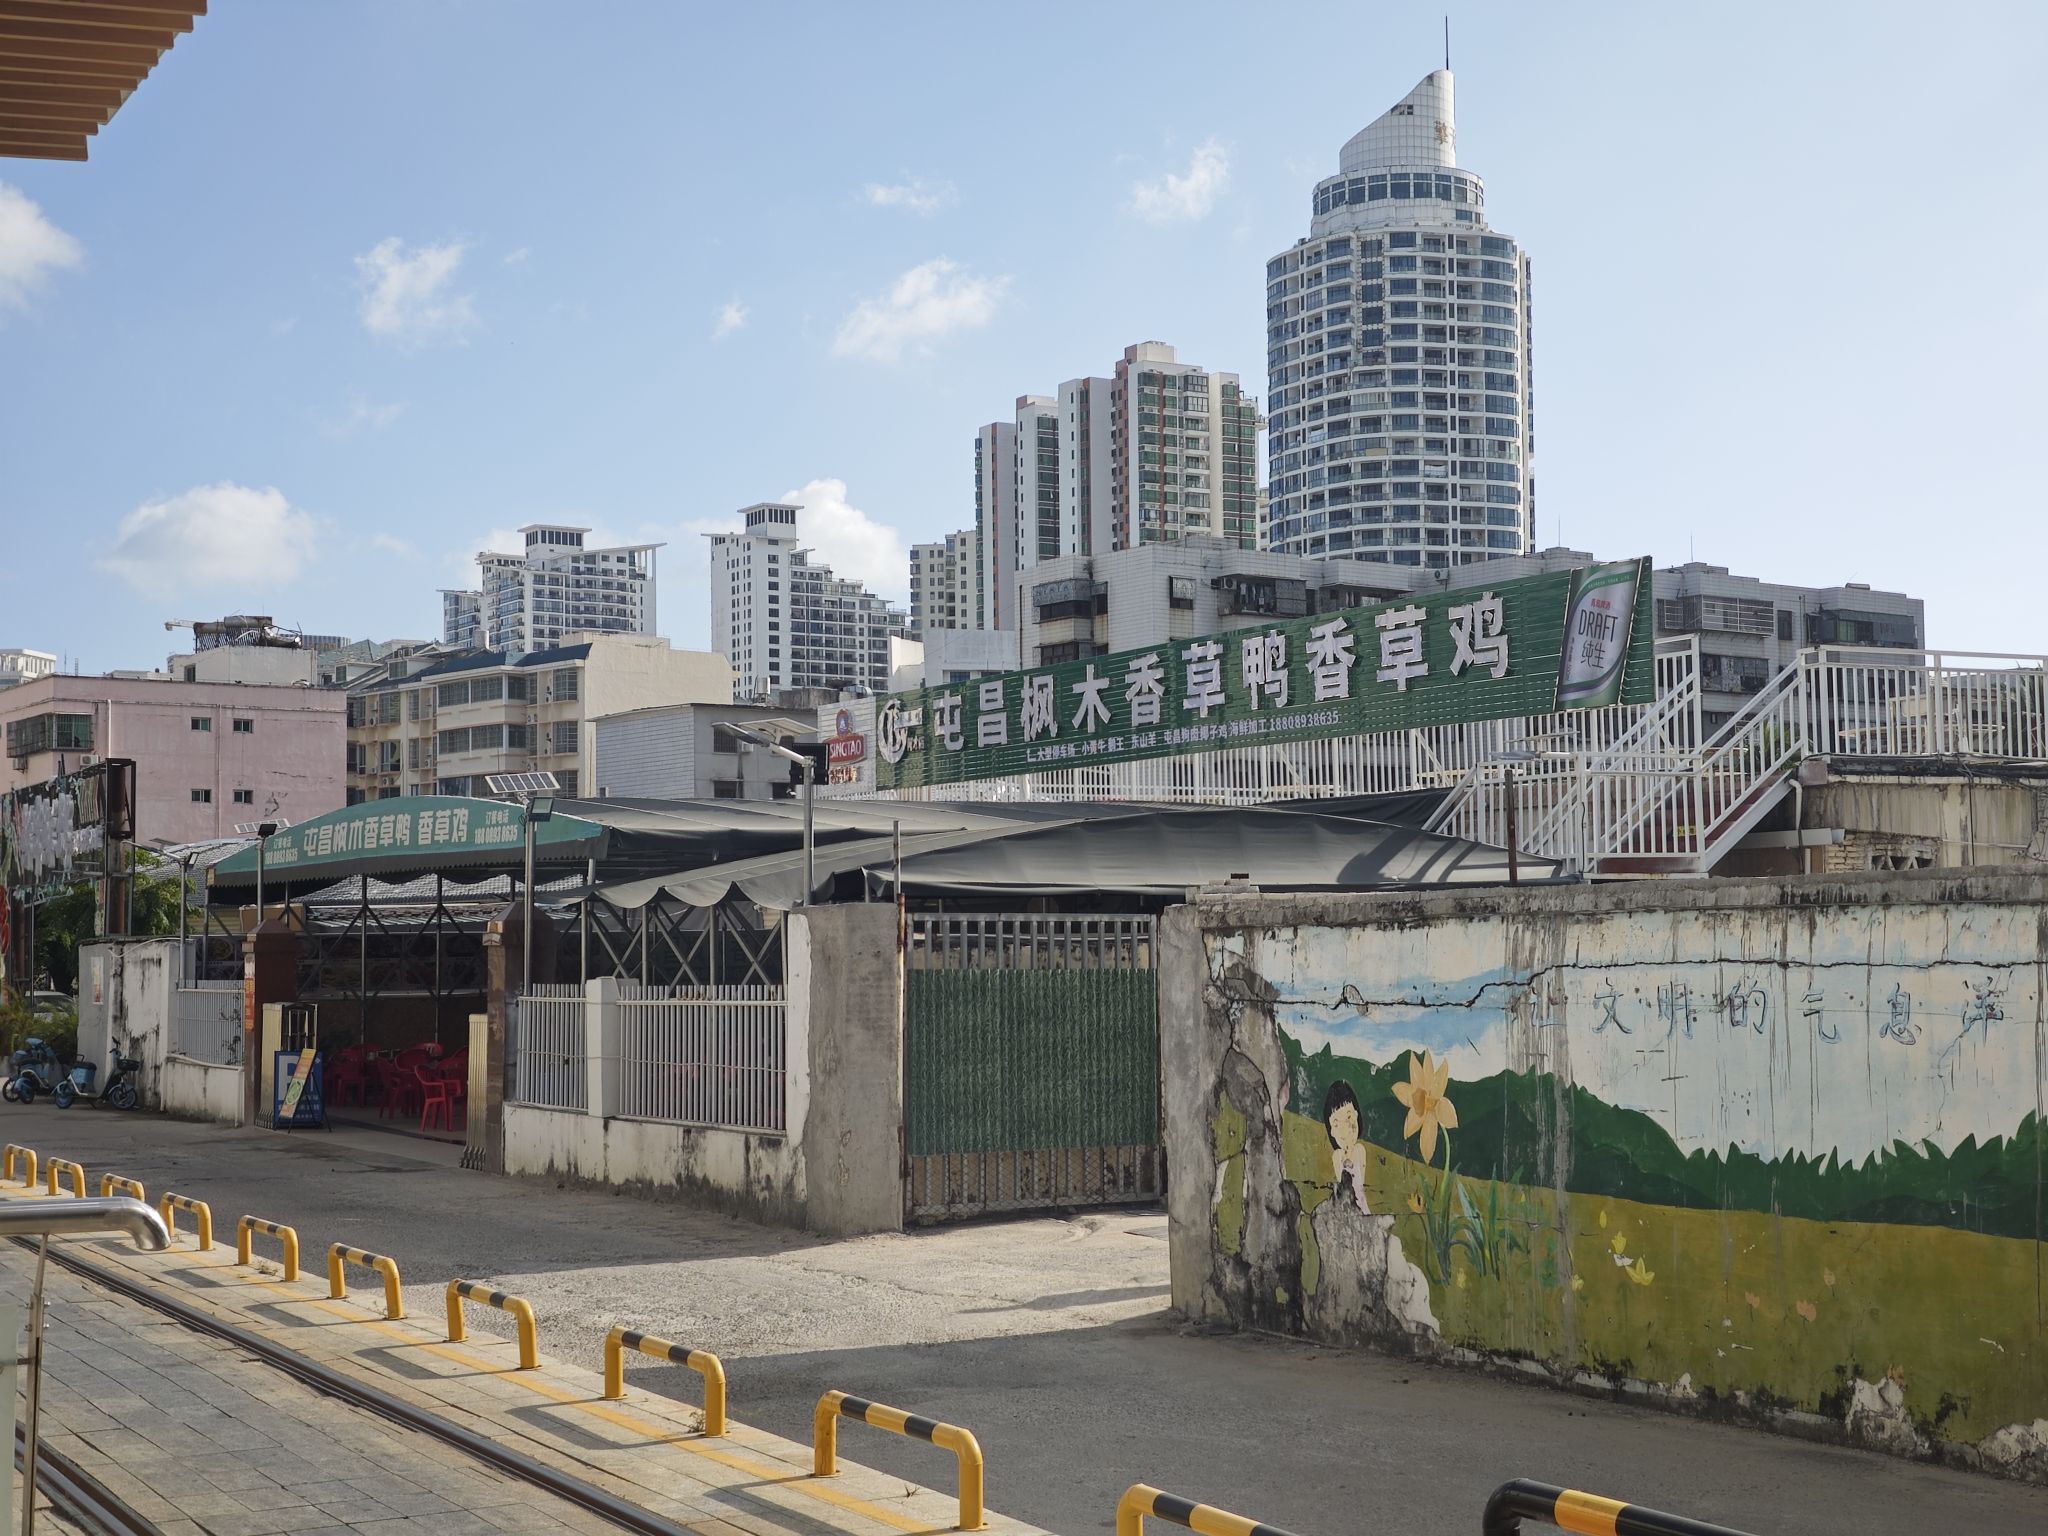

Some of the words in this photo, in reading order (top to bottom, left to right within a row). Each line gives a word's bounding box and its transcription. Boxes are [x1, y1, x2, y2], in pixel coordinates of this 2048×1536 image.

[1578, 609, 1618, 643] DRAFT
[1580, 640, 1605, 669] 纯生
[932, 592, 1509, 751] 屯昌枫木香草鸭香草鸡
[1269, 710, 1339, 731] 18808938635
[829, 739, 861, 758] SINGTAO
[303, 813, 412, 857] 屯昌枫木香草鸭
[418, 807, 469, 845] 香草鸡
